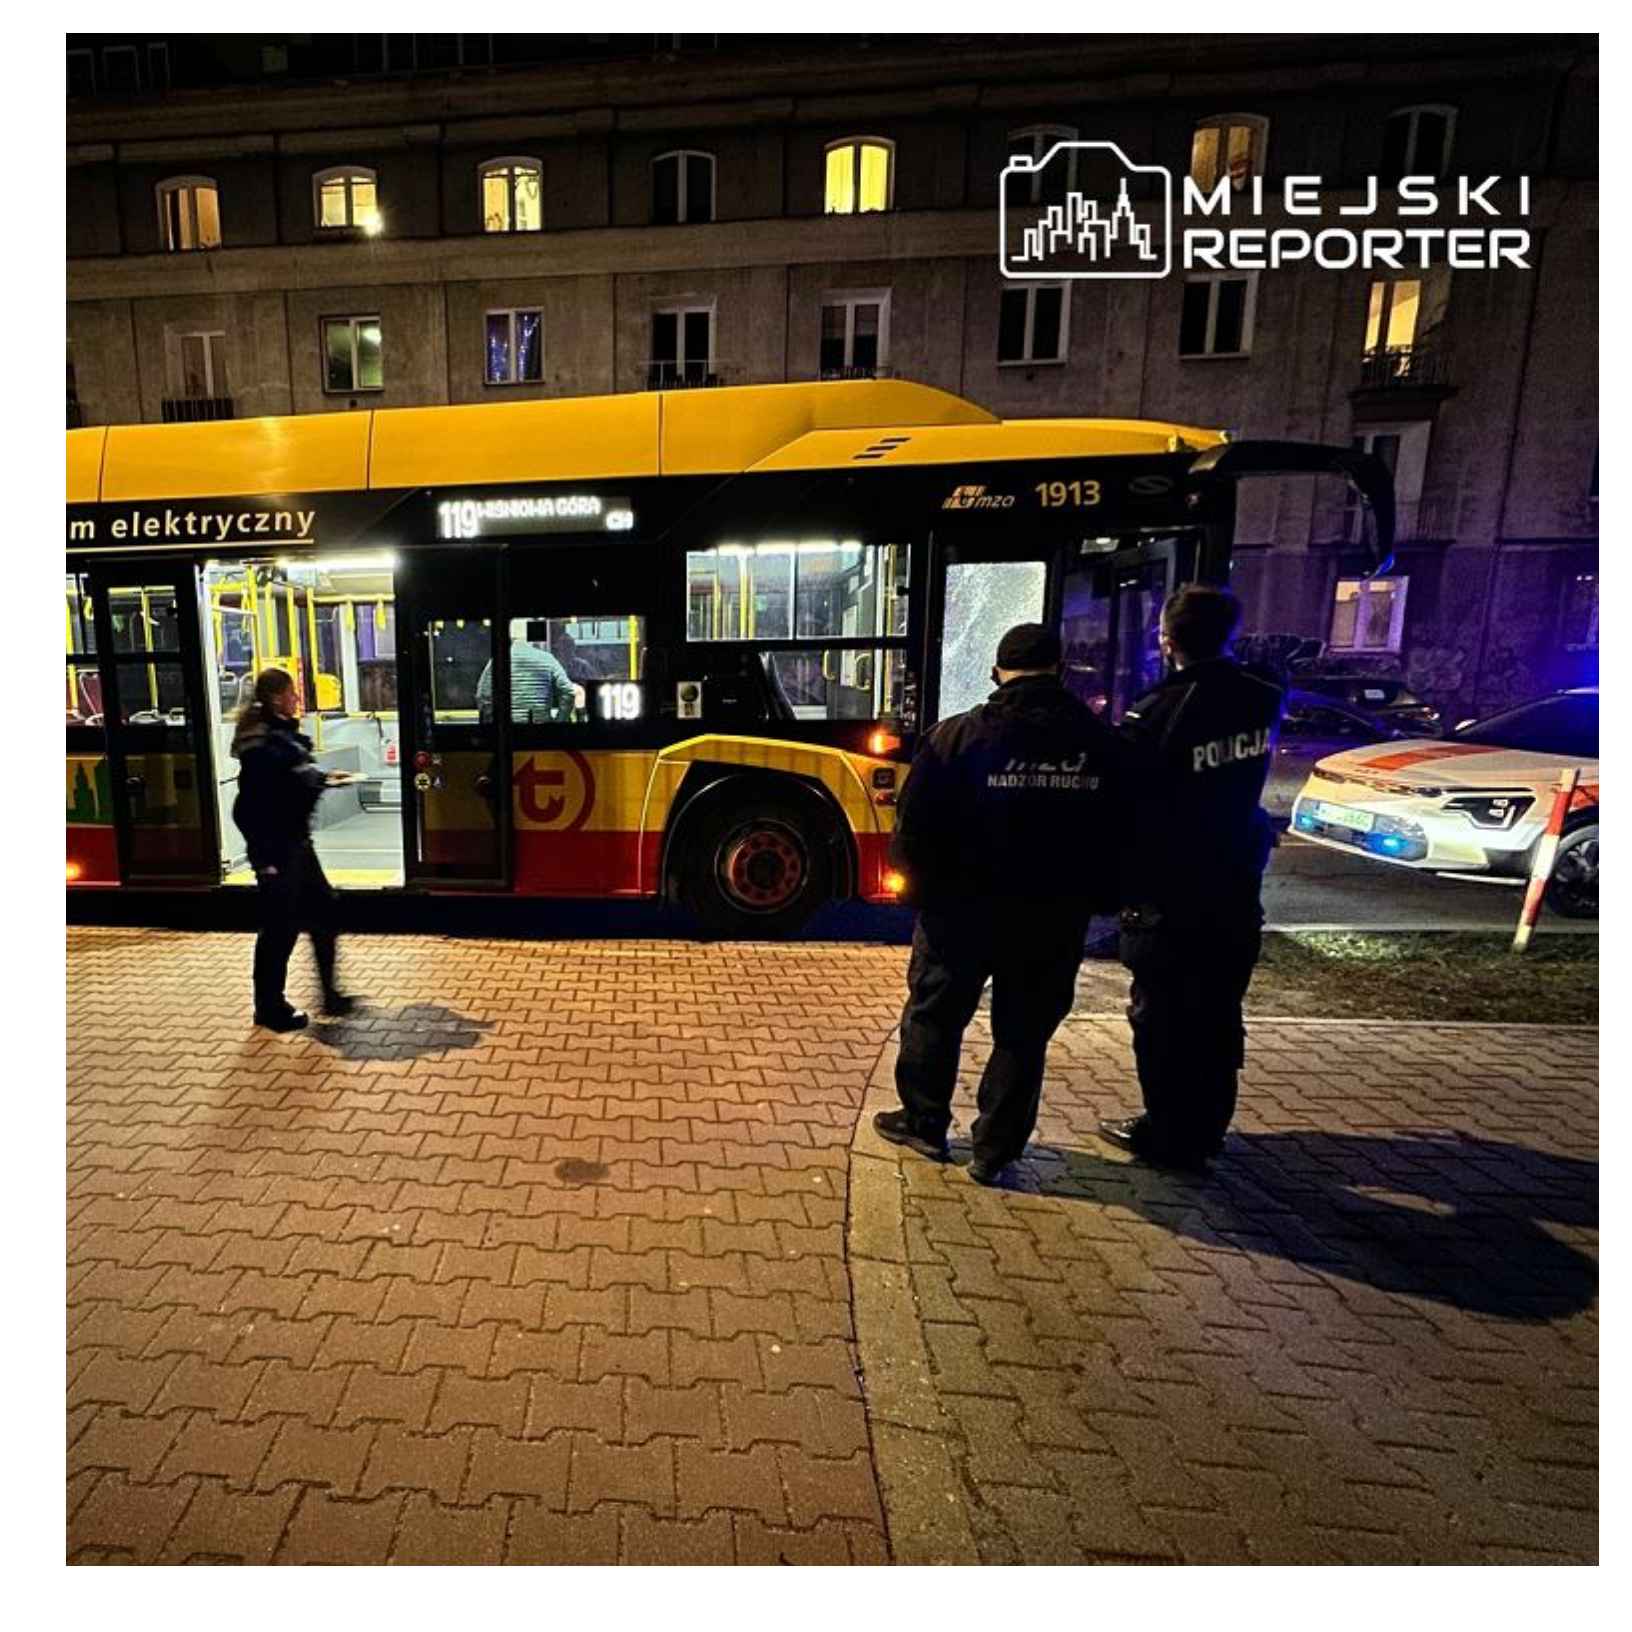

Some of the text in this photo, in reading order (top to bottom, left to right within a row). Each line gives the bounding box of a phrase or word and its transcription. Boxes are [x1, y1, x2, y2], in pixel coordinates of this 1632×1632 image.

[1035, 480, 1101, 507] 1913
[111, 509, 315, 540] elektryczny
[438, 500, 480, 538] 119
[600, 683, 640, 720] 119
